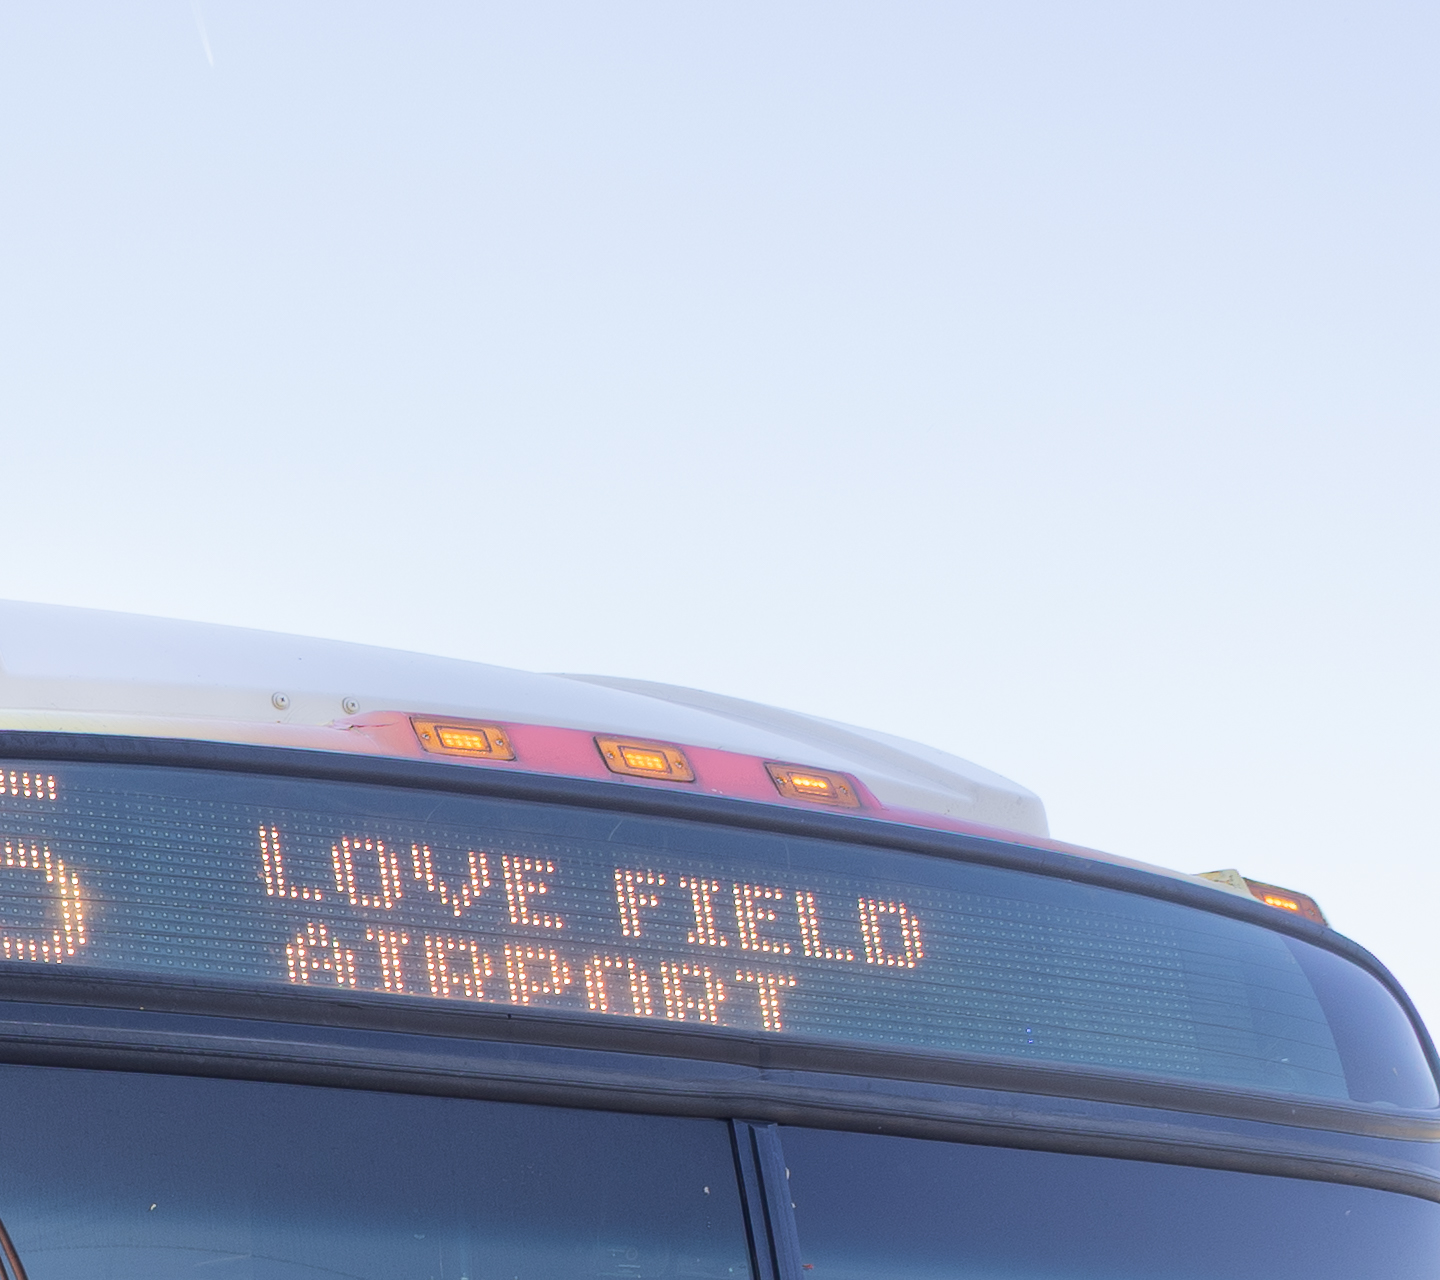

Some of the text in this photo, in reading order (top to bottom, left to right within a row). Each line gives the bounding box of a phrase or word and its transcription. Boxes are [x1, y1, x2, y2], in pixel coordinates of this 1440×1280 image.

[256, 822, 925, 971] LOVE FIELD
[284, 922, 799, 1034] AIRPORT
